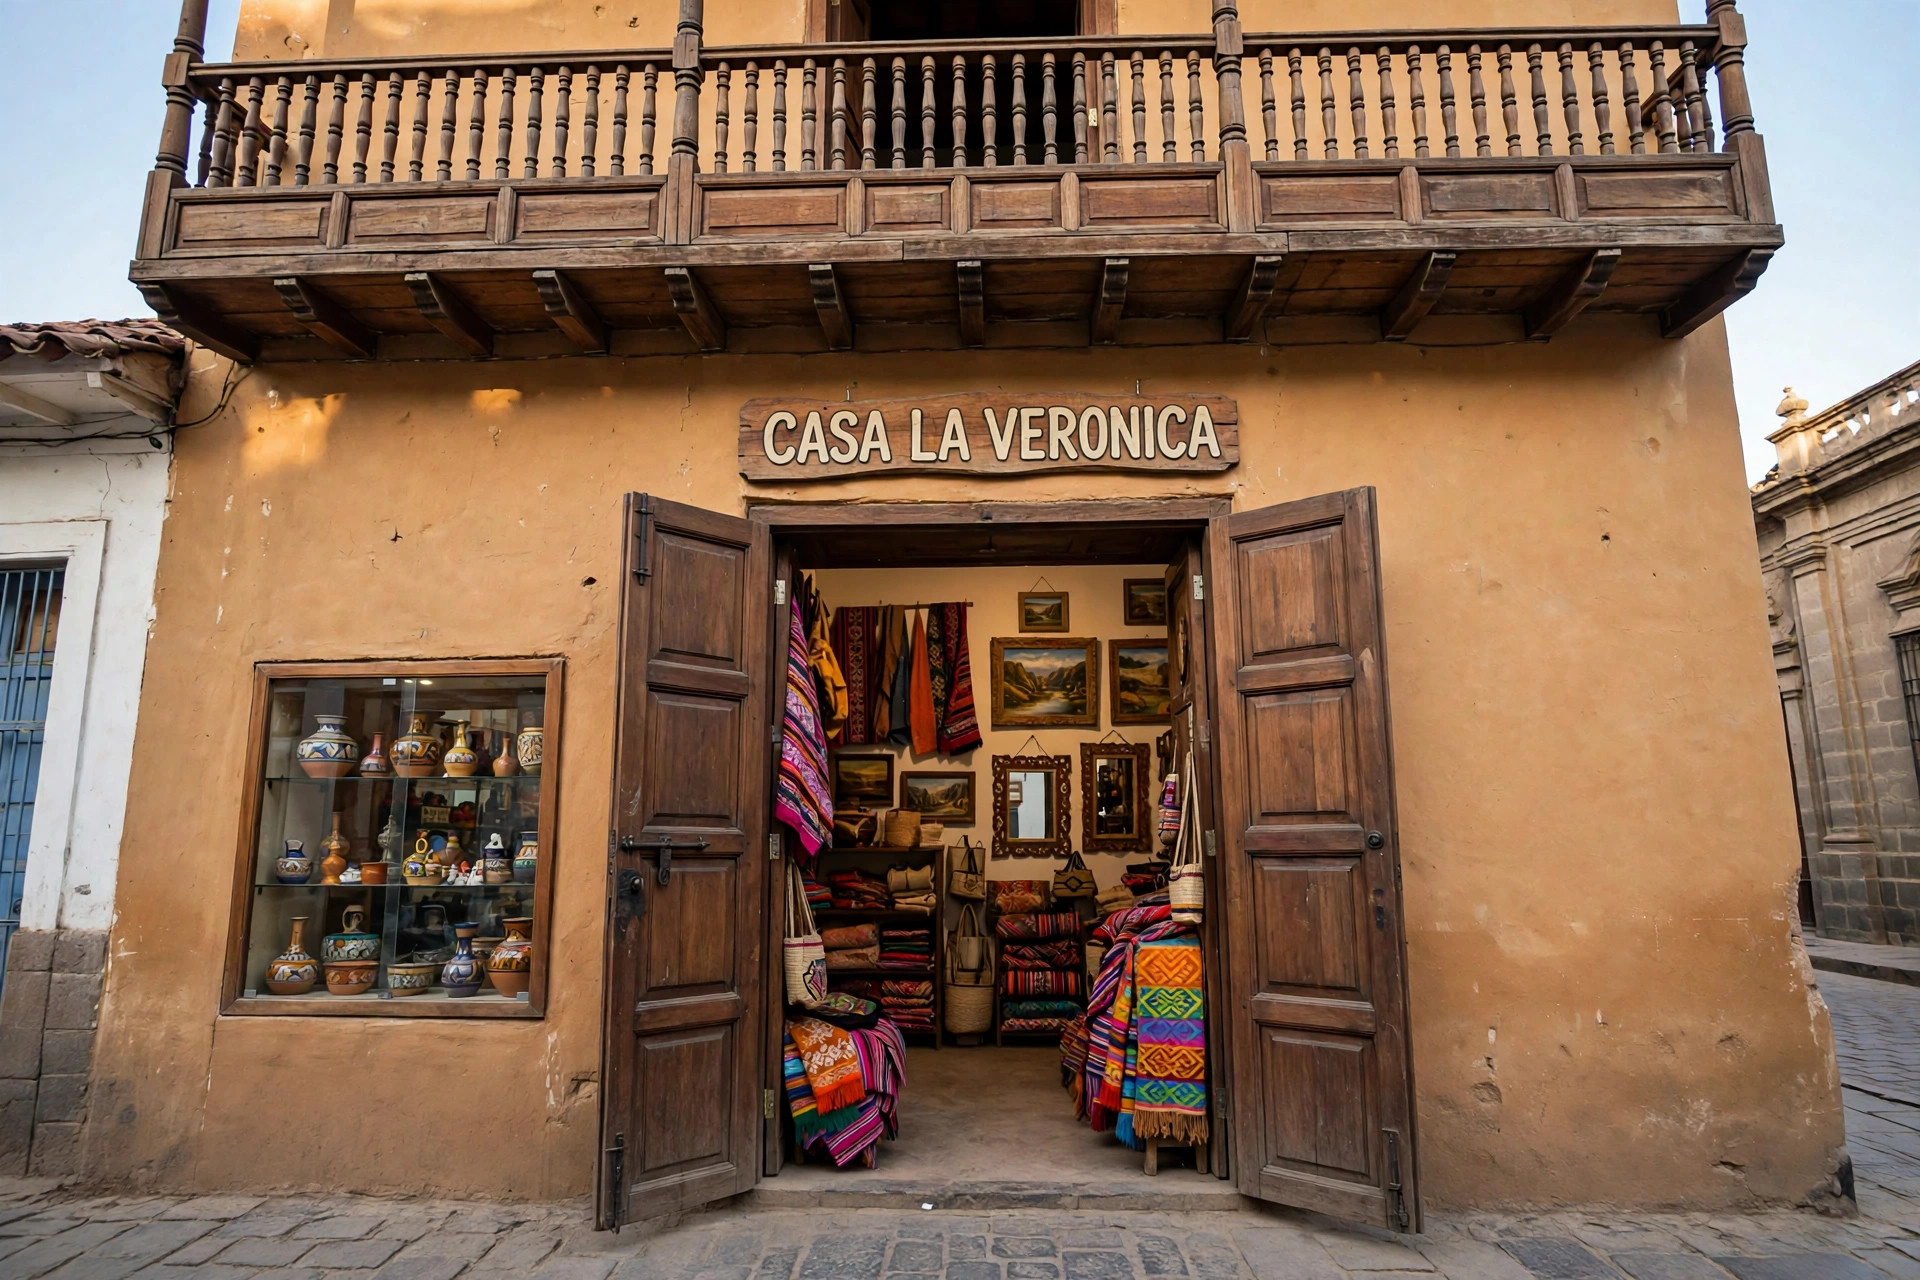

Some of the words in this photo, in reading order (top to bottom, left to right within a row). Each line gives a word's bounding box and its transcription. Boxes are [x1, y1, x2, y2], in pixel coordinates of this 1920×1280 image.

[762, 410, 892, 465] CASA
[910, 407, 971, 462] LA
[984, 404, 1222, 461] VERONICA
